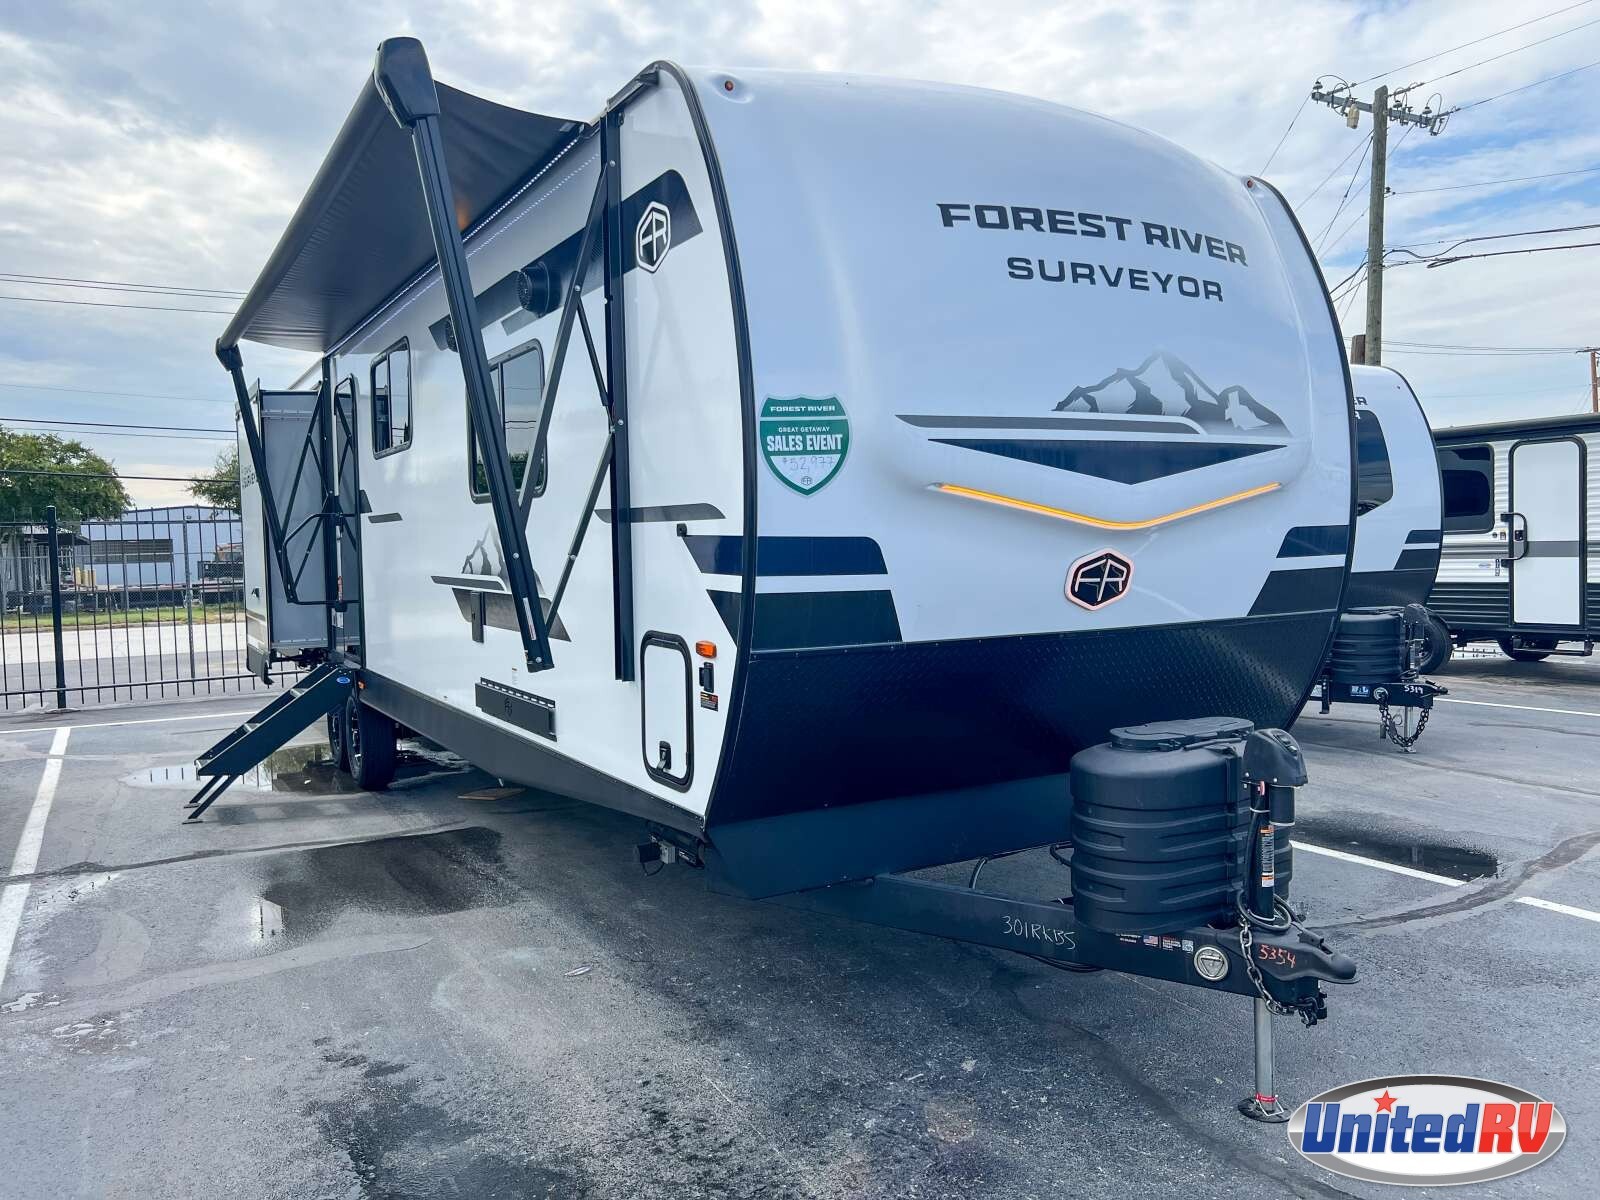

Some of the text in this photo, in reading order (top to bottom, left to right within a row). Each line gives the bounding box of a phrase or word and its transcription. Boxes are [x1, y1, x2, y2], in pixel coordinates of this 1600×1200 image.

[936, 203, 1248, 267] FOREST RIVER
[1007, 256, 1224, 302] SURVEYOR
[766, 433, 843, 452] SALES EVENT
[1258, 944, 1297, 969] 5354
